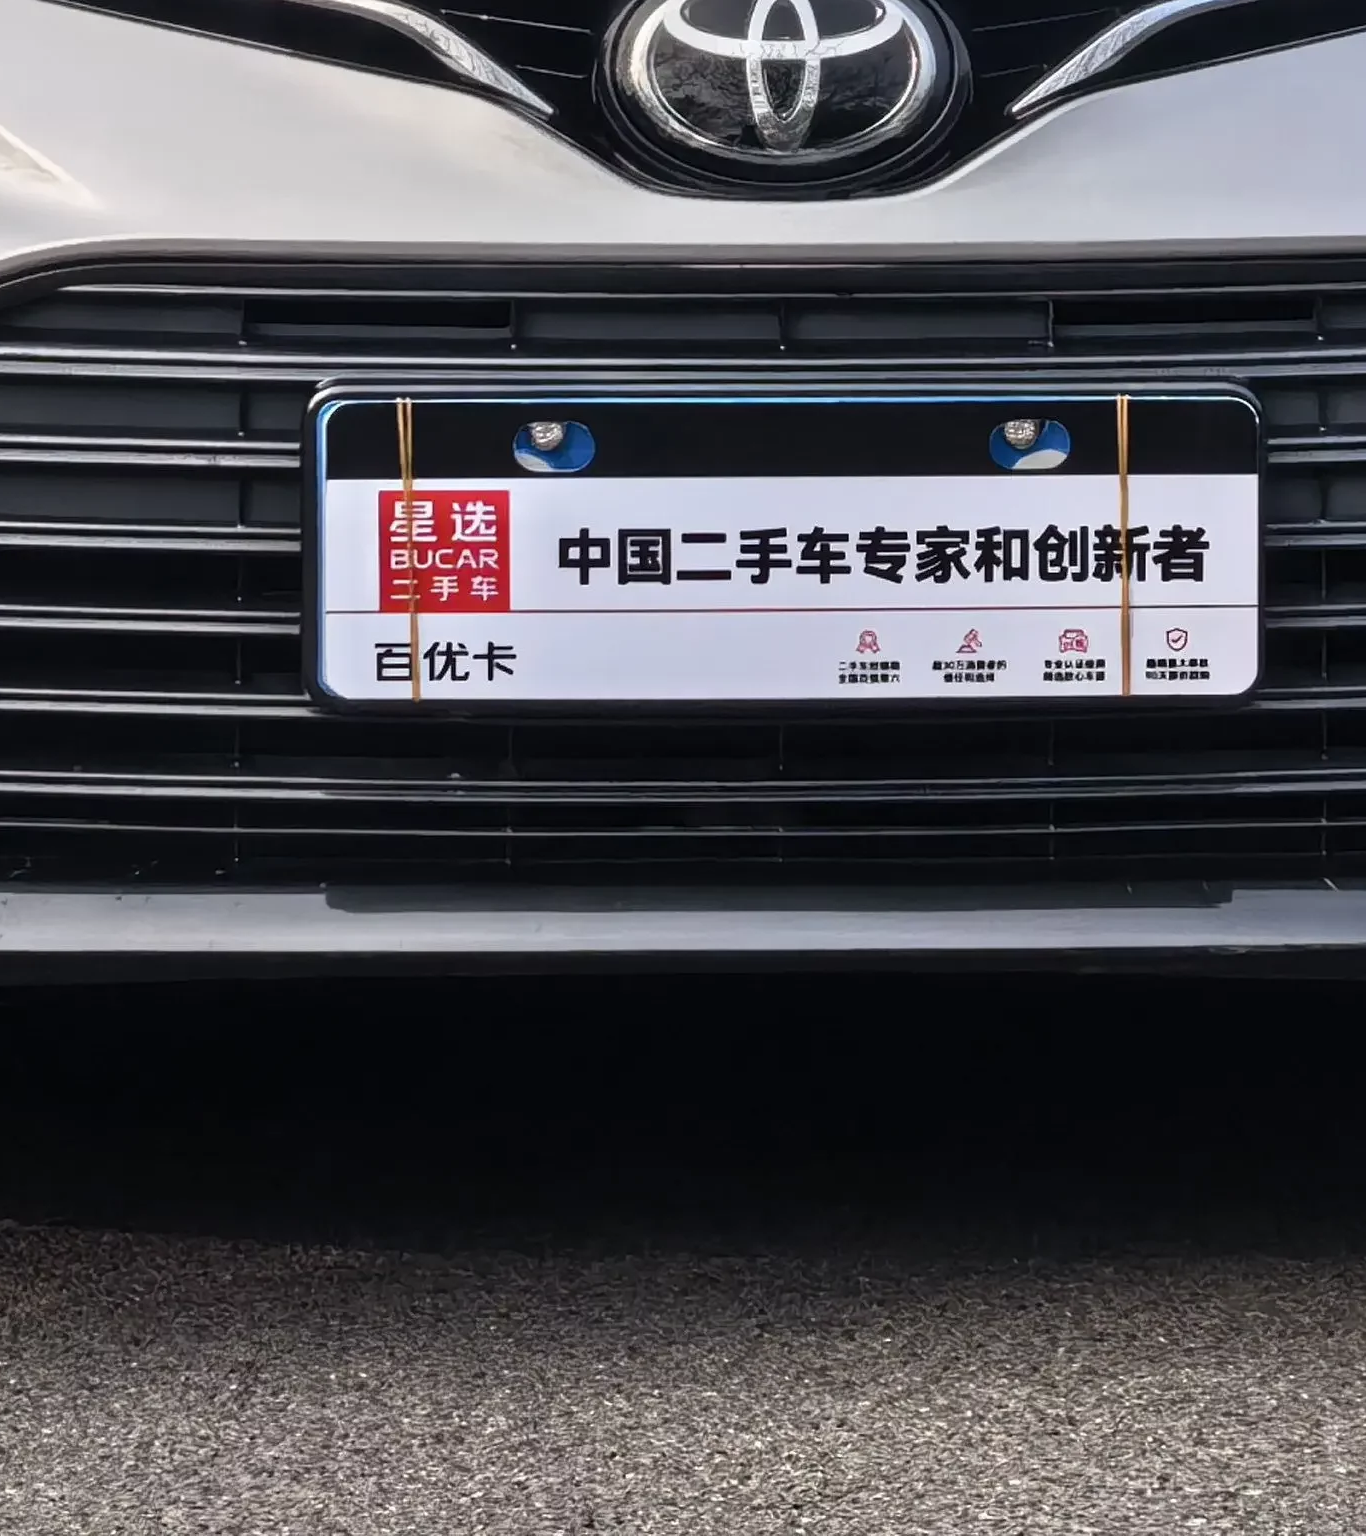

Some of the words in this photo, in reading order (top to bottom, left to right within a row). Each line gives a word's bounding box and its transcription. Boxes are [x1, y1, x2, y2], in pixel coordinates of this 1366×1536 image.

[389, 500, 498, 543] 星选
[390, 548, 500, 570] BUCAR
[558, 524, 1210, 586] 中国二手车专家和创新者
[390, 575, 499, 602] 二手车
[374, 641, 517, 682] 百优卡
